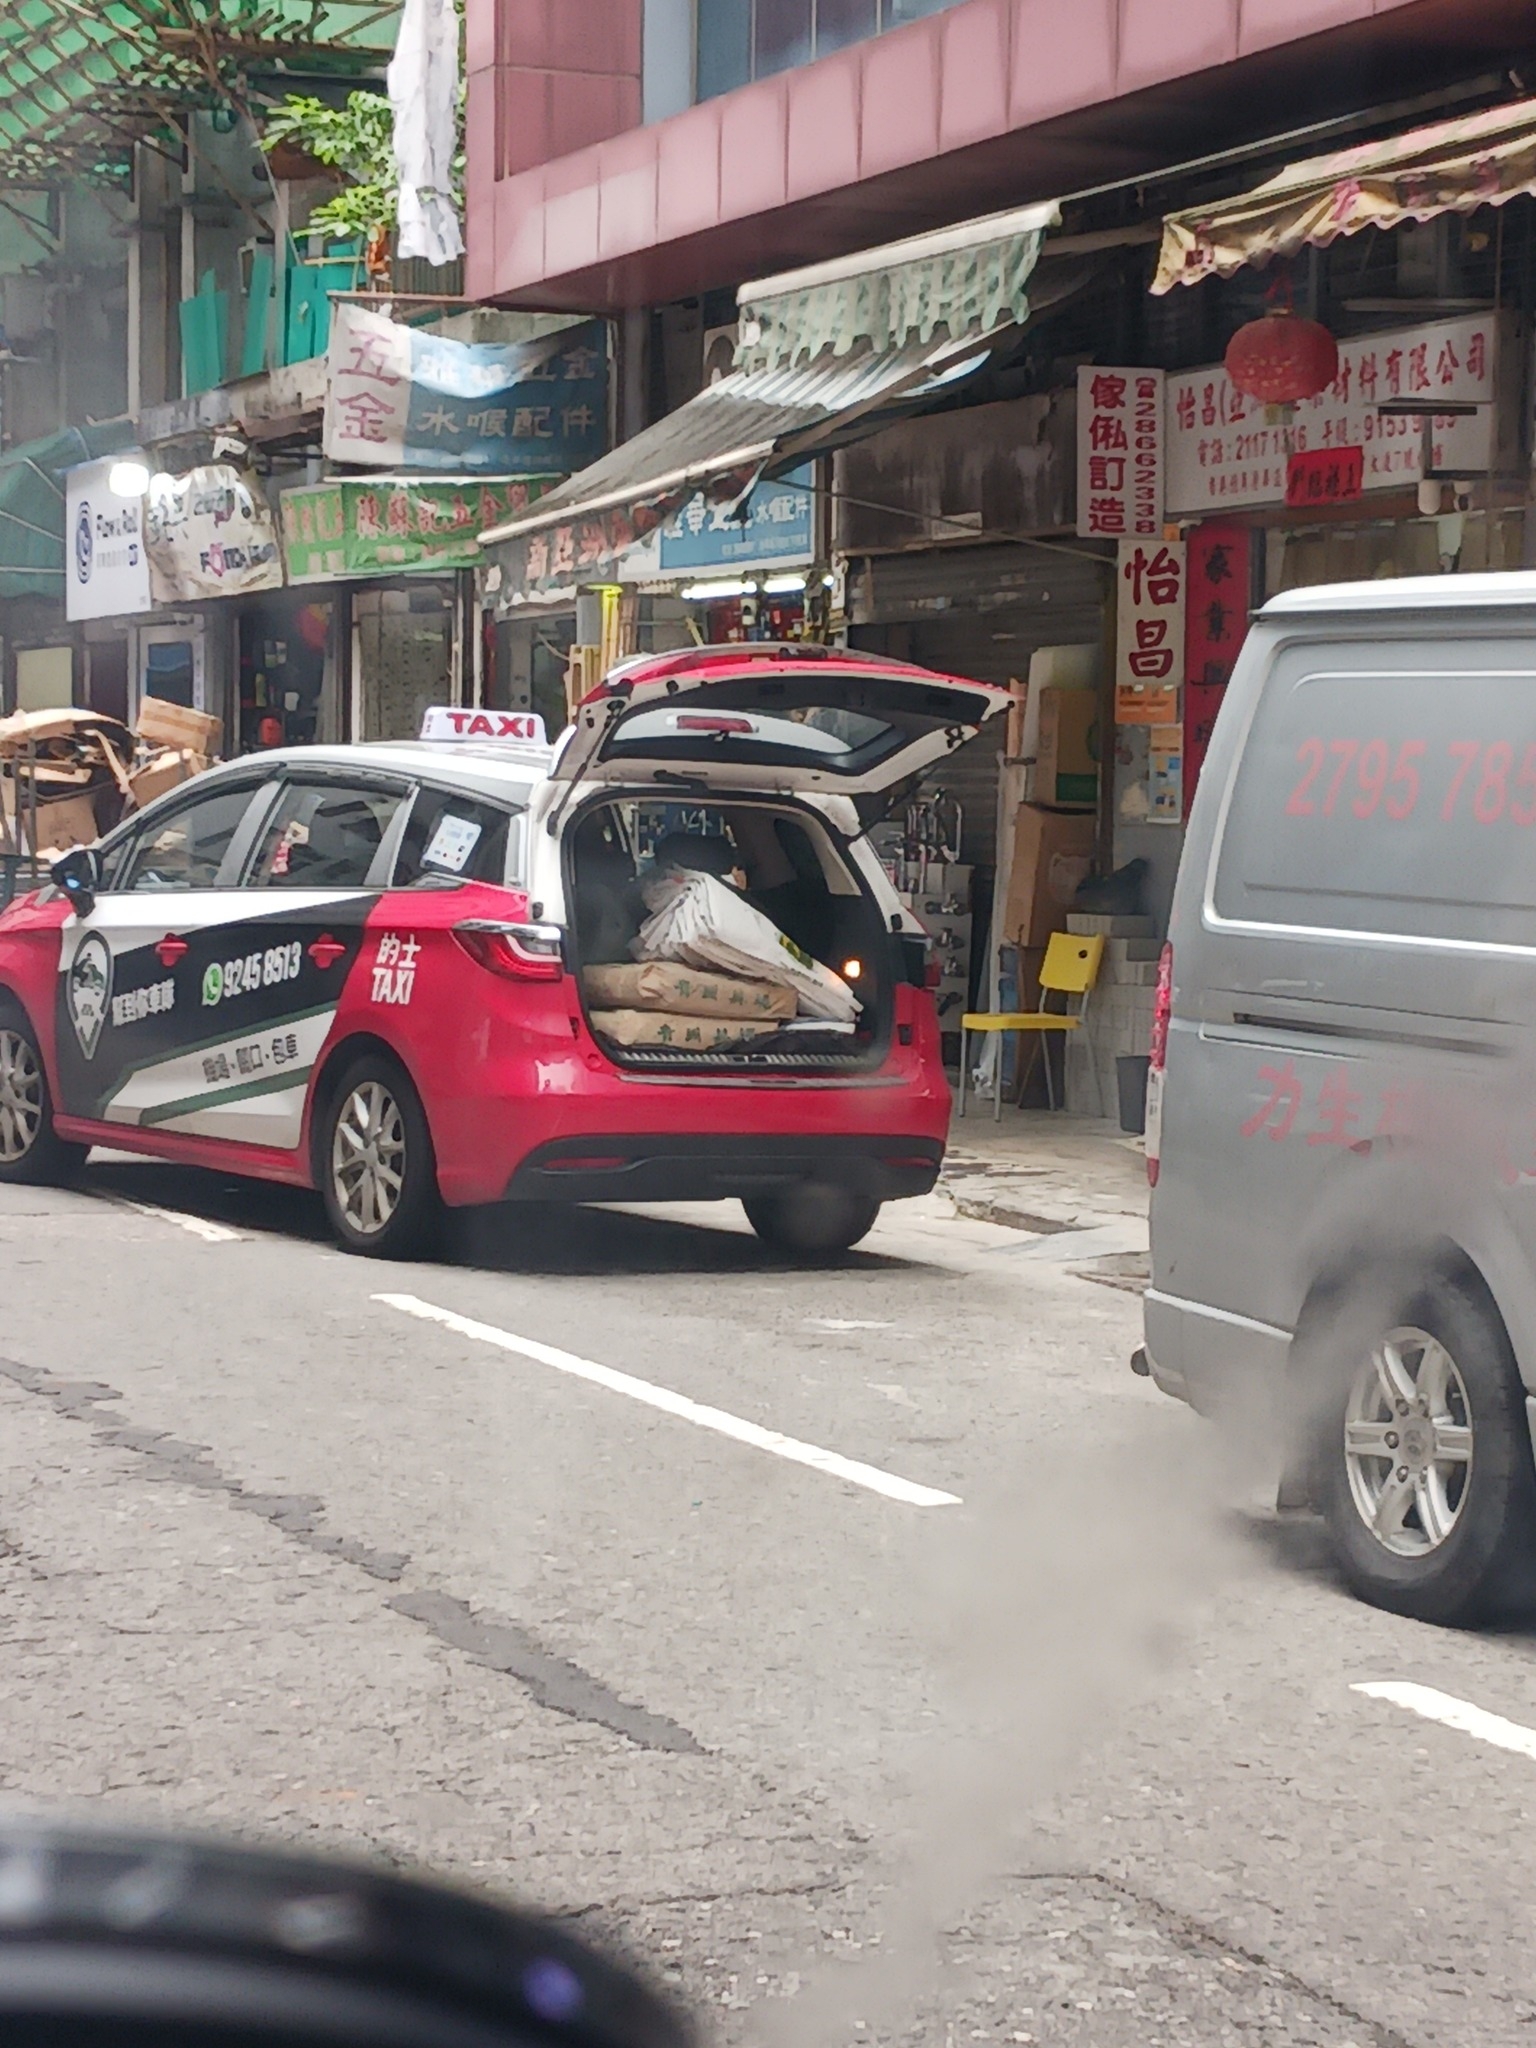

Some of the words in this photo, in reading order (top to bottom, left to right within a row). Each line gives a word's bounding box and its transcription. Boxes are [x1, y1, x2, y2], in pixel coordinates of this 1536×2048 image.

[337, 328, 401, 444] 五金
[417, 404, 598, 439] 水喉配件
[1089, 374, 1128, 534] 傢俬訂造
[1134, 401, 1157, 535] 28662338
[1124, 547, 1181, 678] 怡昌
[446, 712, 536, 739] TAXI
[1284, 736, 1429, 821] 2795
[222, 953, 263, 998] 9245
[263, 941, 302, 986] 8513
[371, 966, 415, 1005] TAXI
[375, 932, 421, 969] 的士
